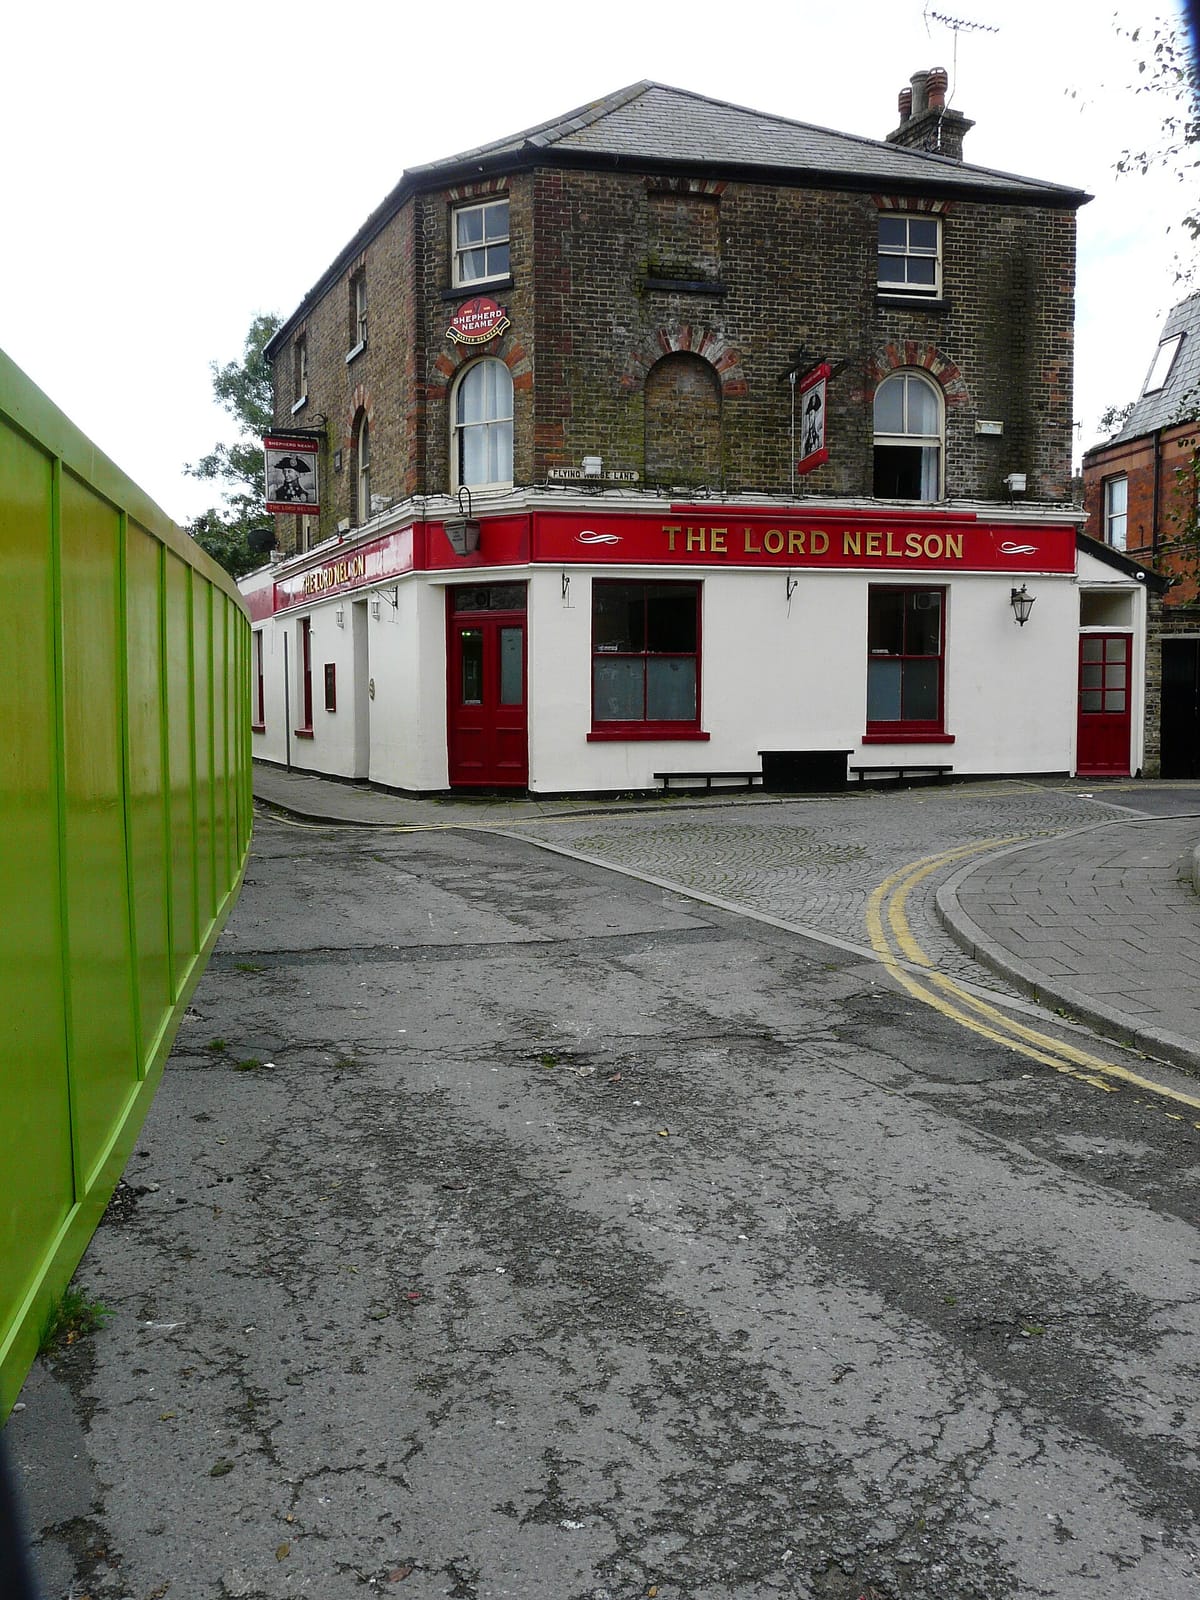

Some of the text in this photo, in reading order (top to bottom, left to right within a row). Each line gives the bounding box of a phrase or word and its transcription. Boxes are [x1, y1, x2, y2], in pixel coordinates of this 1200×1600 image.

[453, 310, 502, 325] SHEPHERD
[461, 319, 493, 331] NEAME
[553, 469, 580, 478] FLYING
[613, 471, 635, 480] LANE
[662, 525, 963, 559] THE LORD NELSON
[316, 567, 335, 592] LORD
[335, 554, 366, 585] NELON
